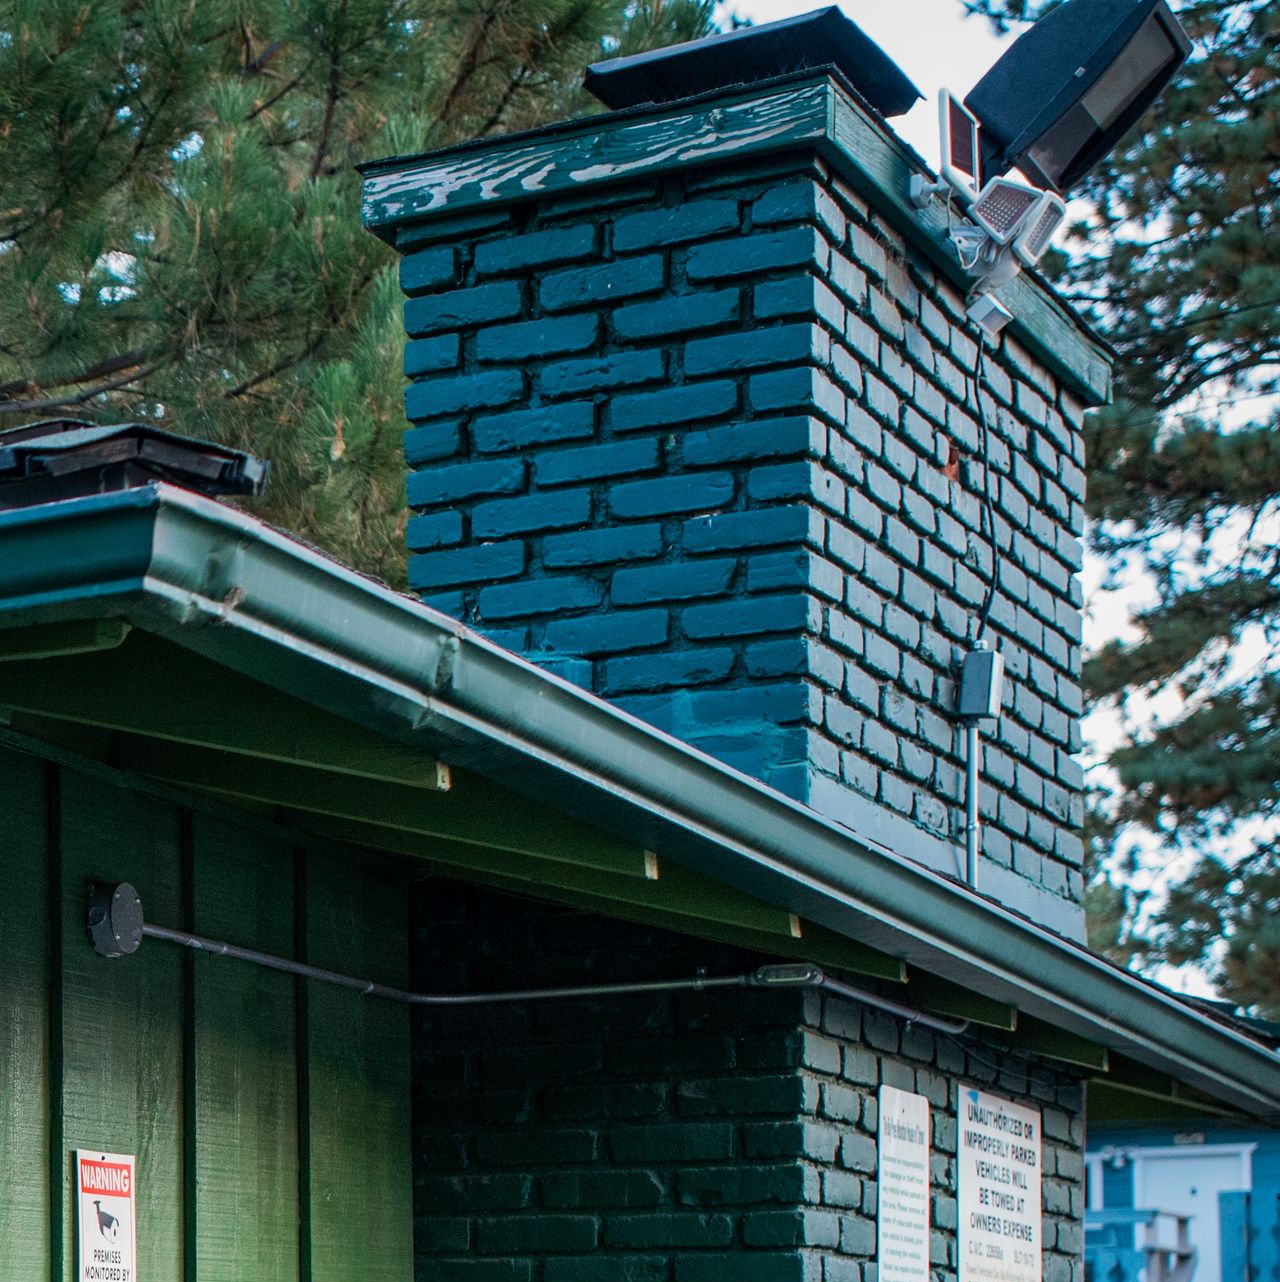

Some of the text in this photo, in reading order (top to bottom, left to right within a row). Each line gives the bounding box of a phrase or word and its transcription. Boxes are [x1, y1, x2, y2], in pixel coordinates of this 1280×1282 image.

[968, 1103, 1034, 1141] UNAUTHORIZED OR
[964, 1129, 1036, 1167] IMPROPERLY PARKED
[81, 1164, 131, 1193] WARNING
[975, 1160, 1028, 1190] VEHICLES WILL
[979, 1187, 1025, 1215] BE TOWED AT
[970, 1212, 1033, 1242] OWNERS EXPENSE
[93, 1249, 122, 1264] PREMISES
[85, 1266, 131, 1282] MONITORED BY
